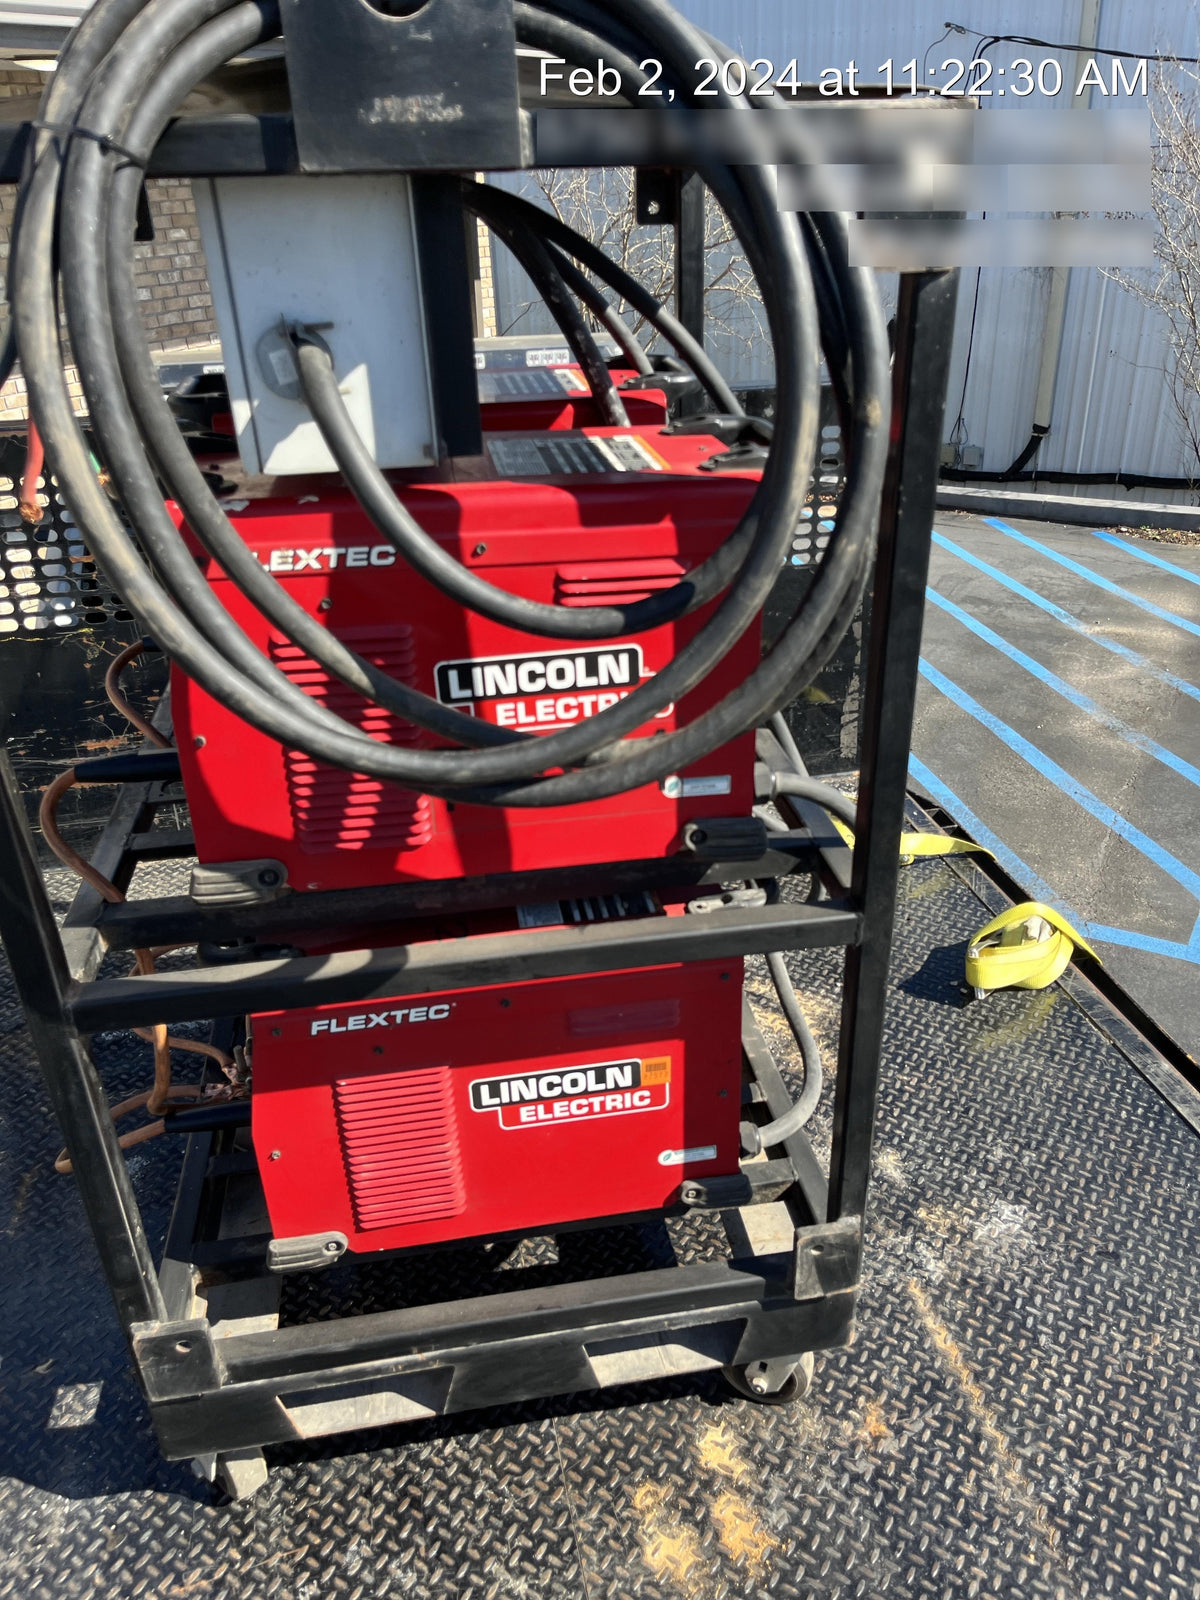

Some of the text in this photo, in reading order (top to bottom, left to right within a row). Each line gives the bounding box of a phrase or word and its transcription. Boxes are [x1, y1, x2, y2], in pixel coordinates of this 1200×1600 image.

[447, 651, 630, 700] LINCOLN
[495, 690, 629, 727] ELECTR
[310, 1003, 451, 1036] FLEXTEC
[479, 1064, 634, 1107] LINCOLN
[519, 1089, 652, 1123] ELECTRIC
